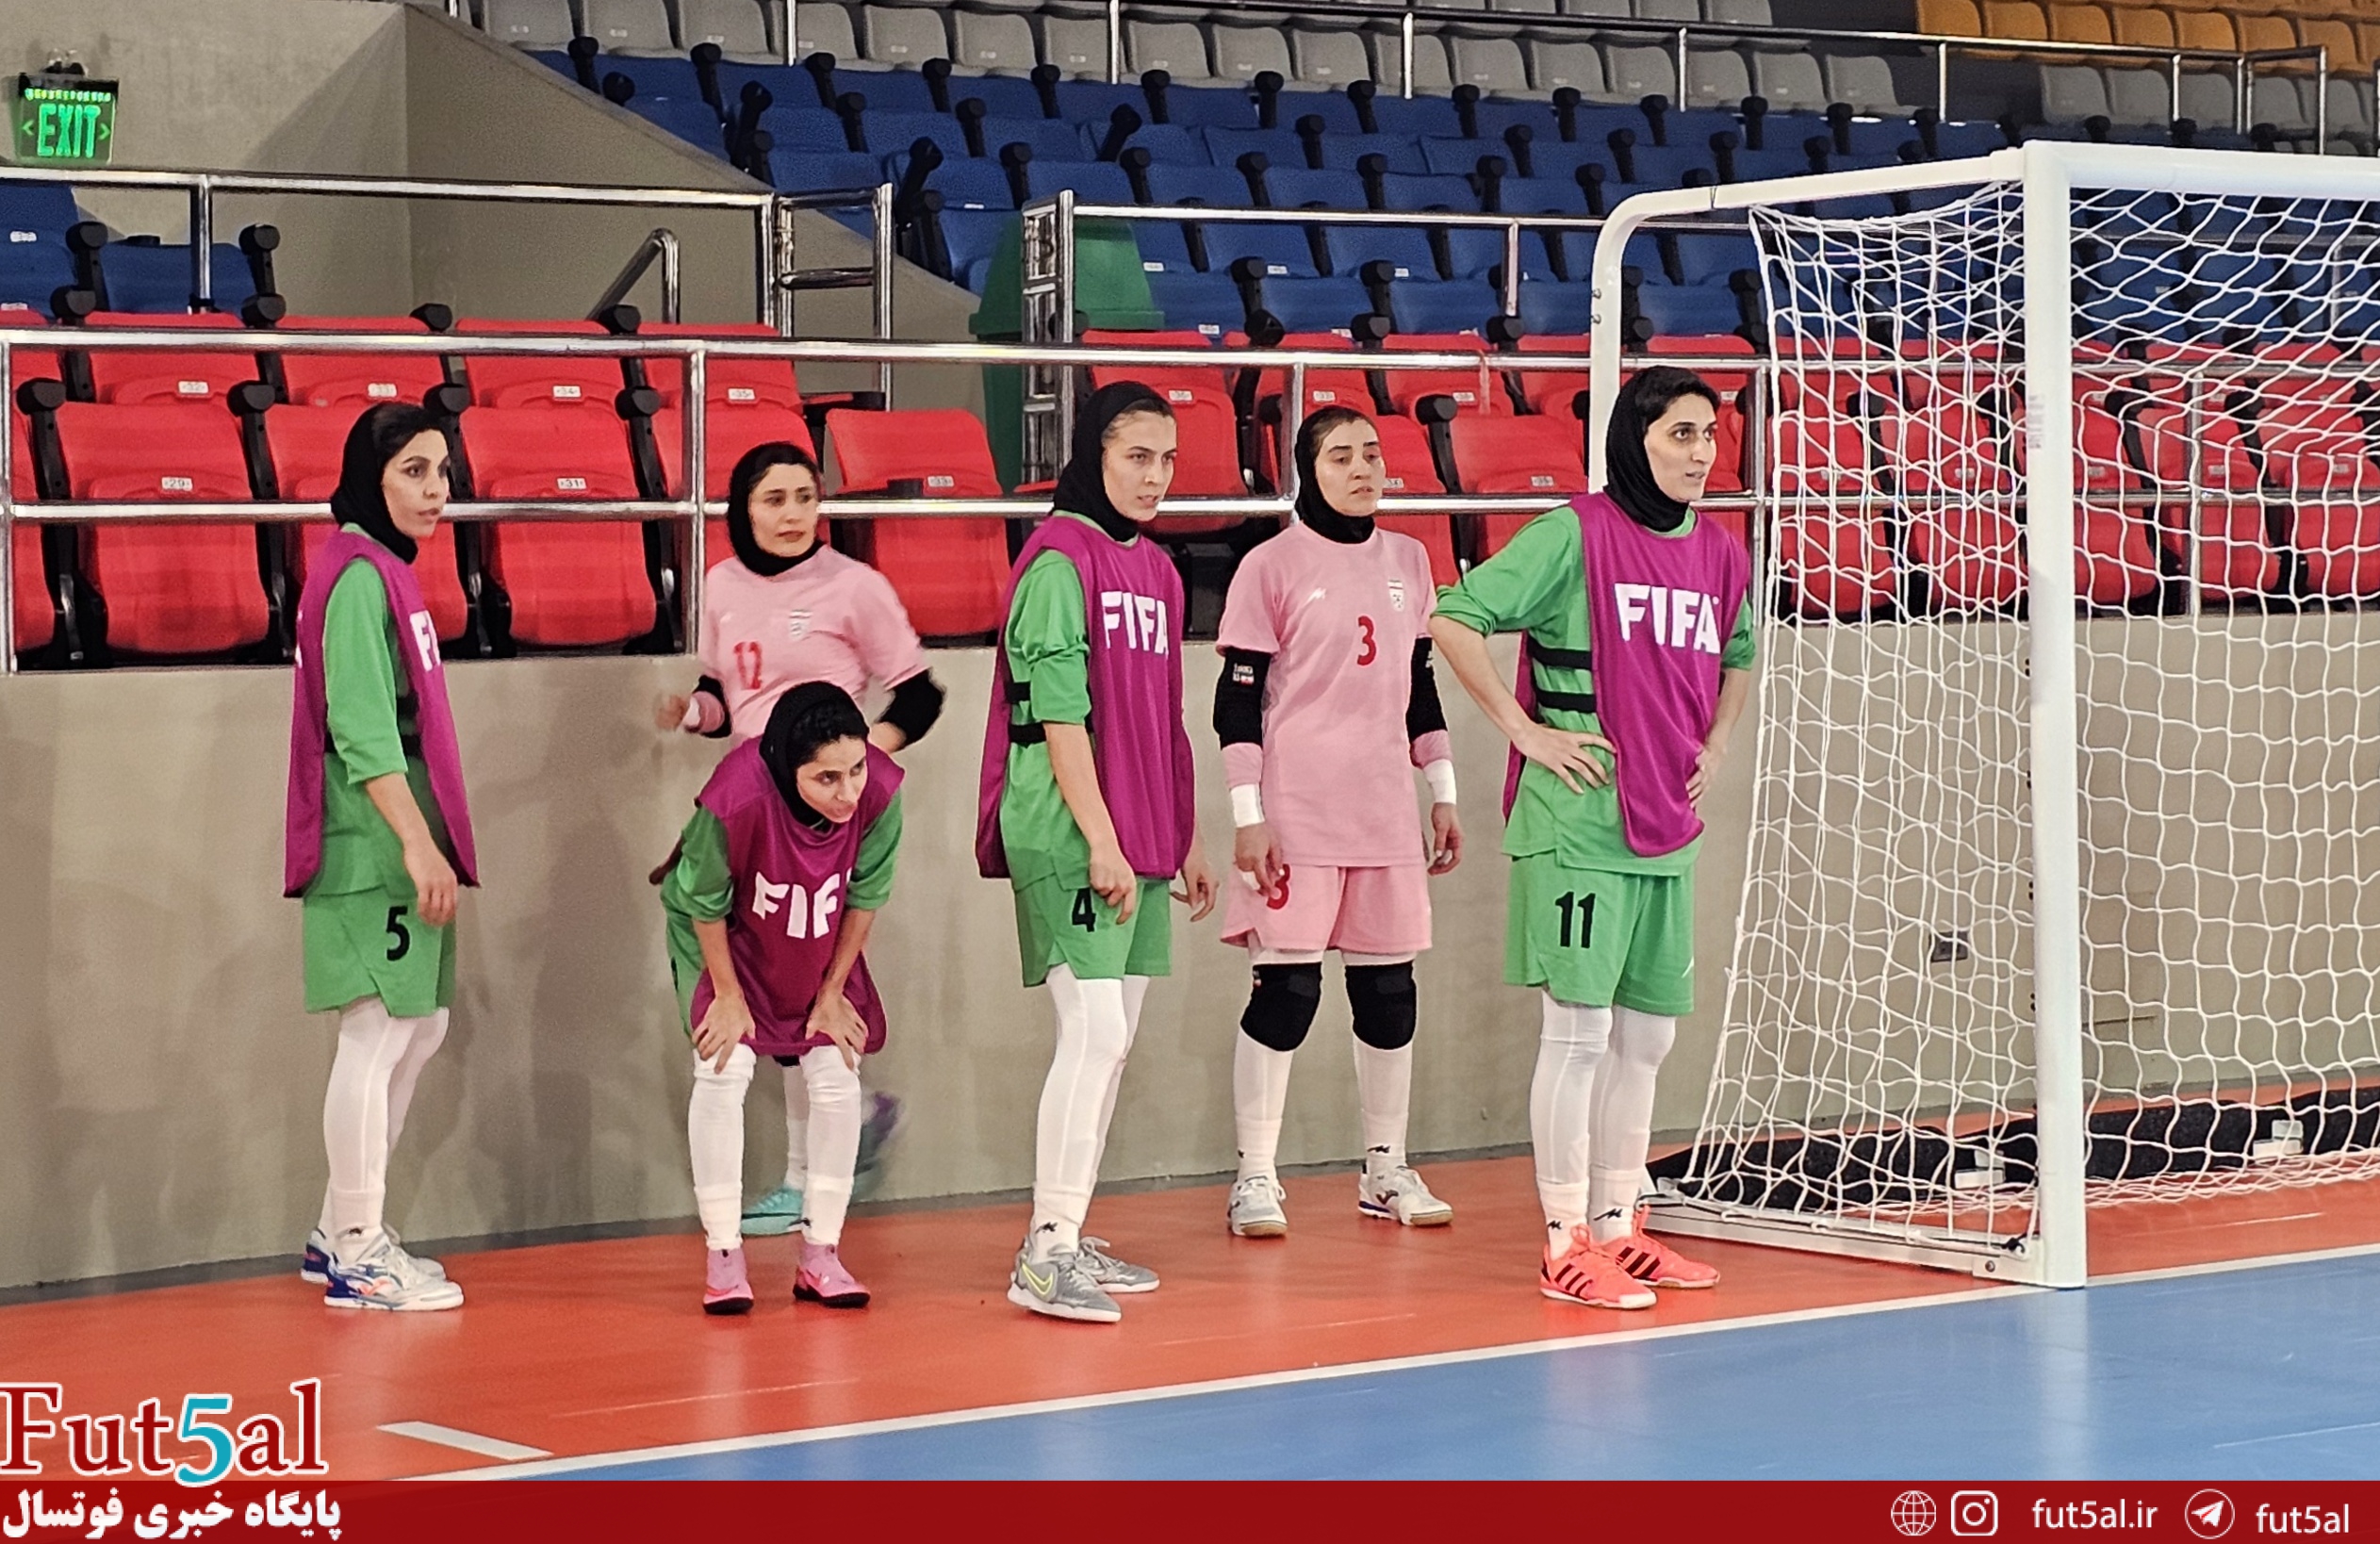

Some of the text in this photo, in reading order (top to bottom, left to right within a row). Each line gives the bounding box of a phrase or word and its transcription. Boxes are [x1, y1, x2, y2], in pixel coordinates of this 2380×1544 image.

[38, 103, 101, 157] EXIT
[410, 609, 441, 672] FI
[1100, 590, 1169, 660] FIFA
[1357, 615, 1377, 666] 3
[1614, 583, 1721, 654] FIFA
[733, 641, 763, 690] 12
[752, 866, 852, 940] FIF
[1072, 887, 1096, 932] 4
[1266, 862, 1291, 911] 3
[386, 905, 411, 961] 5
[1554, 891, 1596, 948] 11
